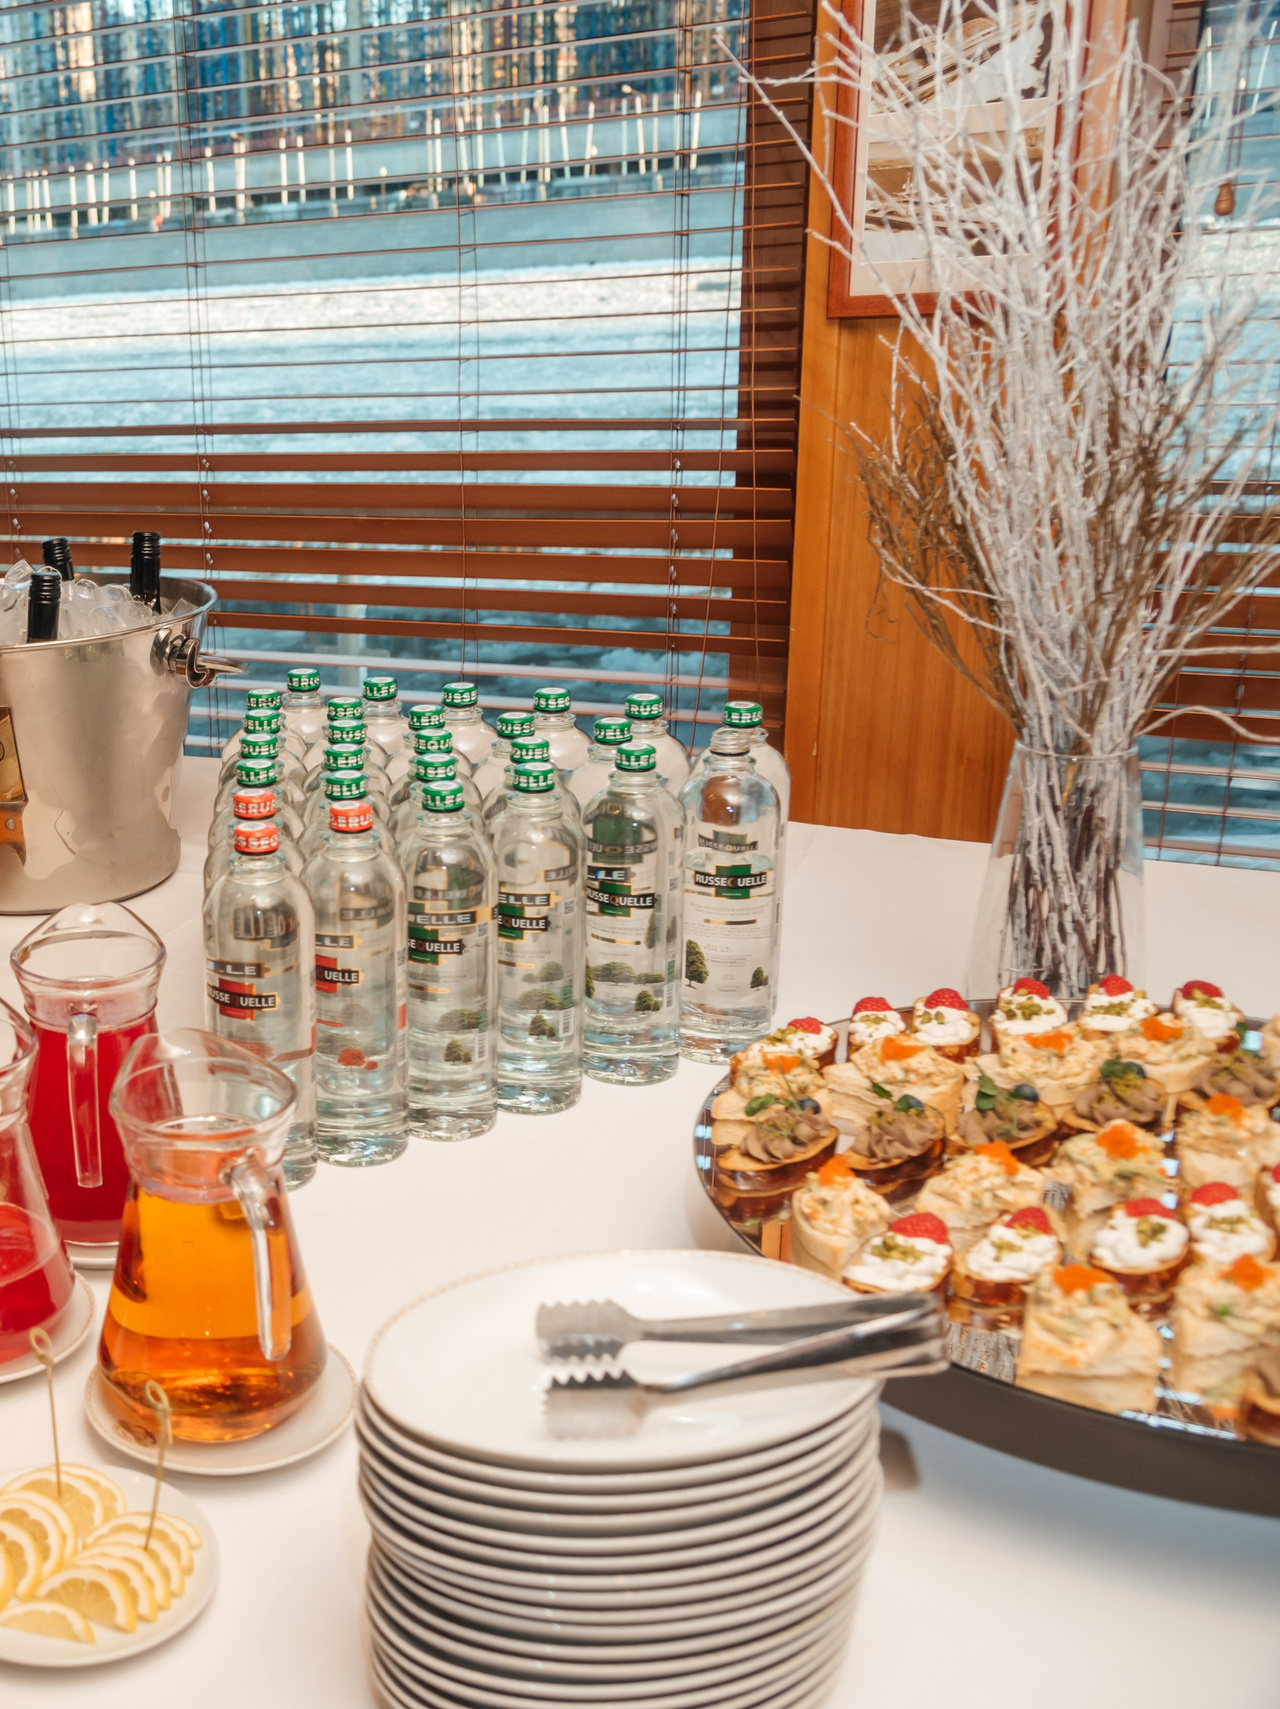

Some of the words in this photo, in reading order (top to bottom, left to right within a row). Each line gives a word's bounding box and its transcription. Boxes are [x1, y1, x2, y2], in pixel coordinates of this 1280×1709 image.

[695, 873, 767, 887] RUSSEQUELLE
[586, 889, 653, 906] RUSSEQUELLE
[207, 982, 276, 1008] RUSSEUELLE
